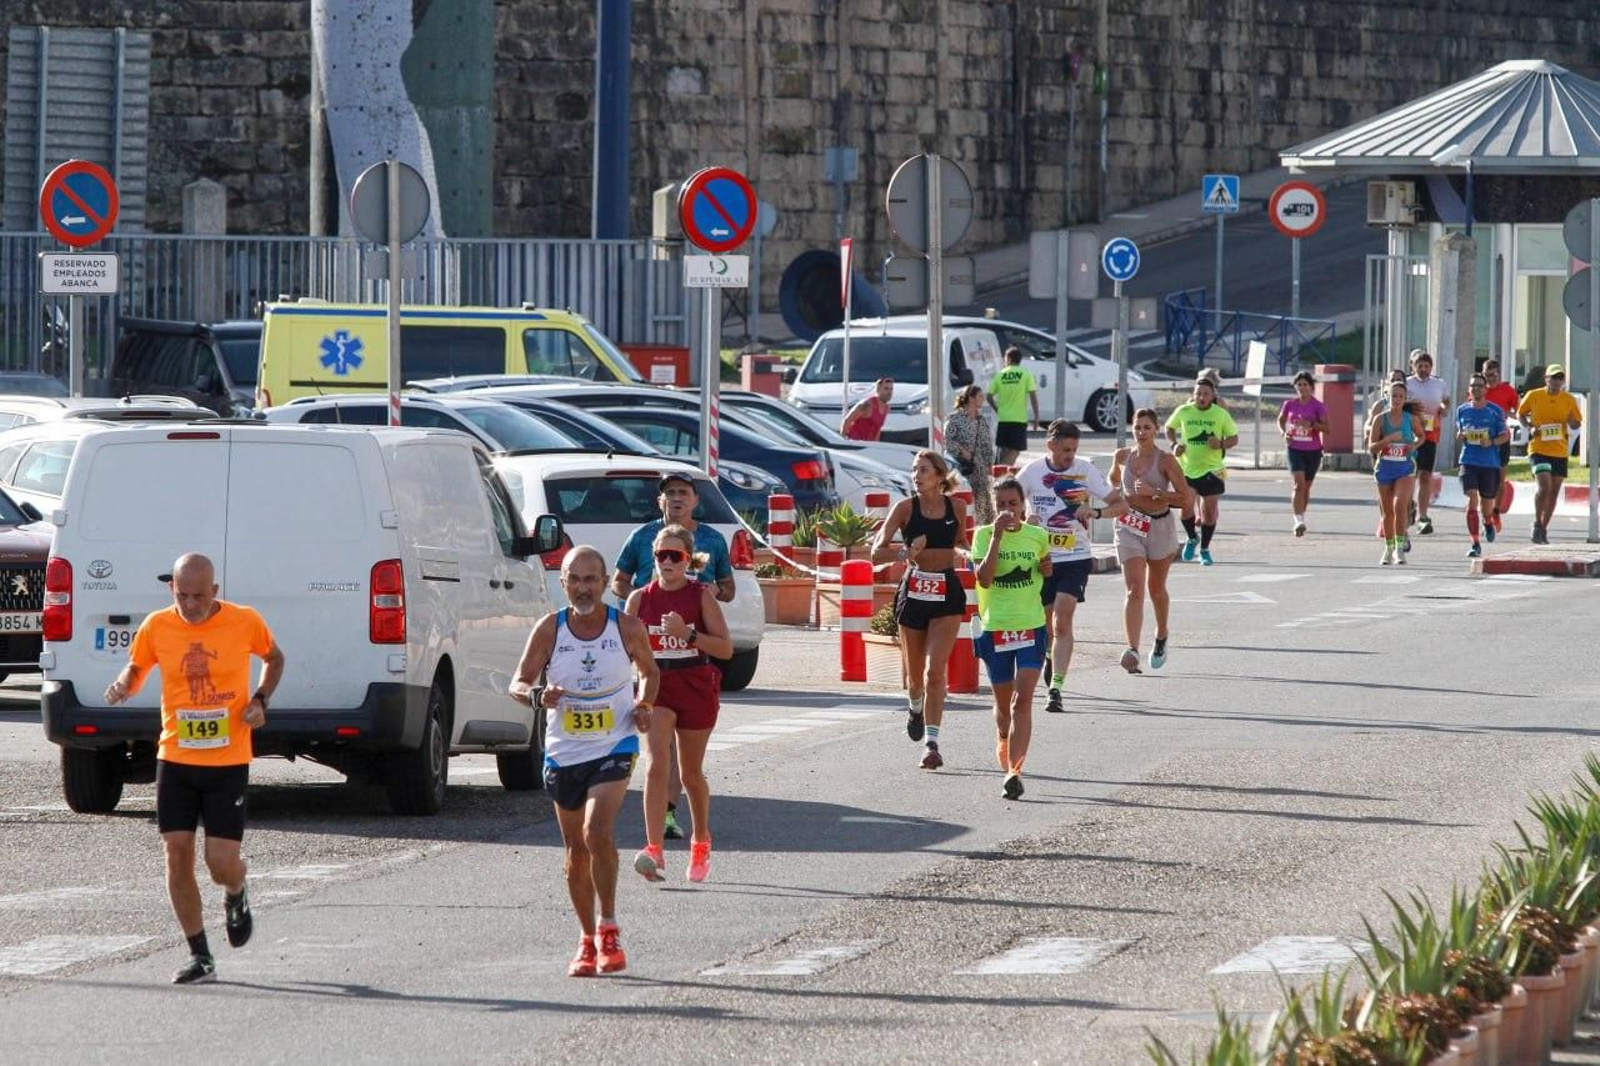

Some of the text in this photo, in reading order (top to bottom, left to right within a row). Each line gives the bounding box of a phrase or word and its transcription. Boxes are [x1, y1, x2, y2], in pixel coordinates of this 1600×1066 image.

[54, 260, 106, 268] RESERVADO
[53, 269, 106, 277] EMPLEADOS
[60, 279, 98, 287] ABANCA
[1001, 371, 1023, 381] ADN
[81, 582, 118, 590] TOYOTA
[309, 580, 361, 591] PROACE
[915, 579, 940, 593] 452
[1001, 630, 1028, 642] 442
[658, 635, 688, 649] 406
[572, 713, 604, 729] 331
[186, 721, 219, 737] 149
